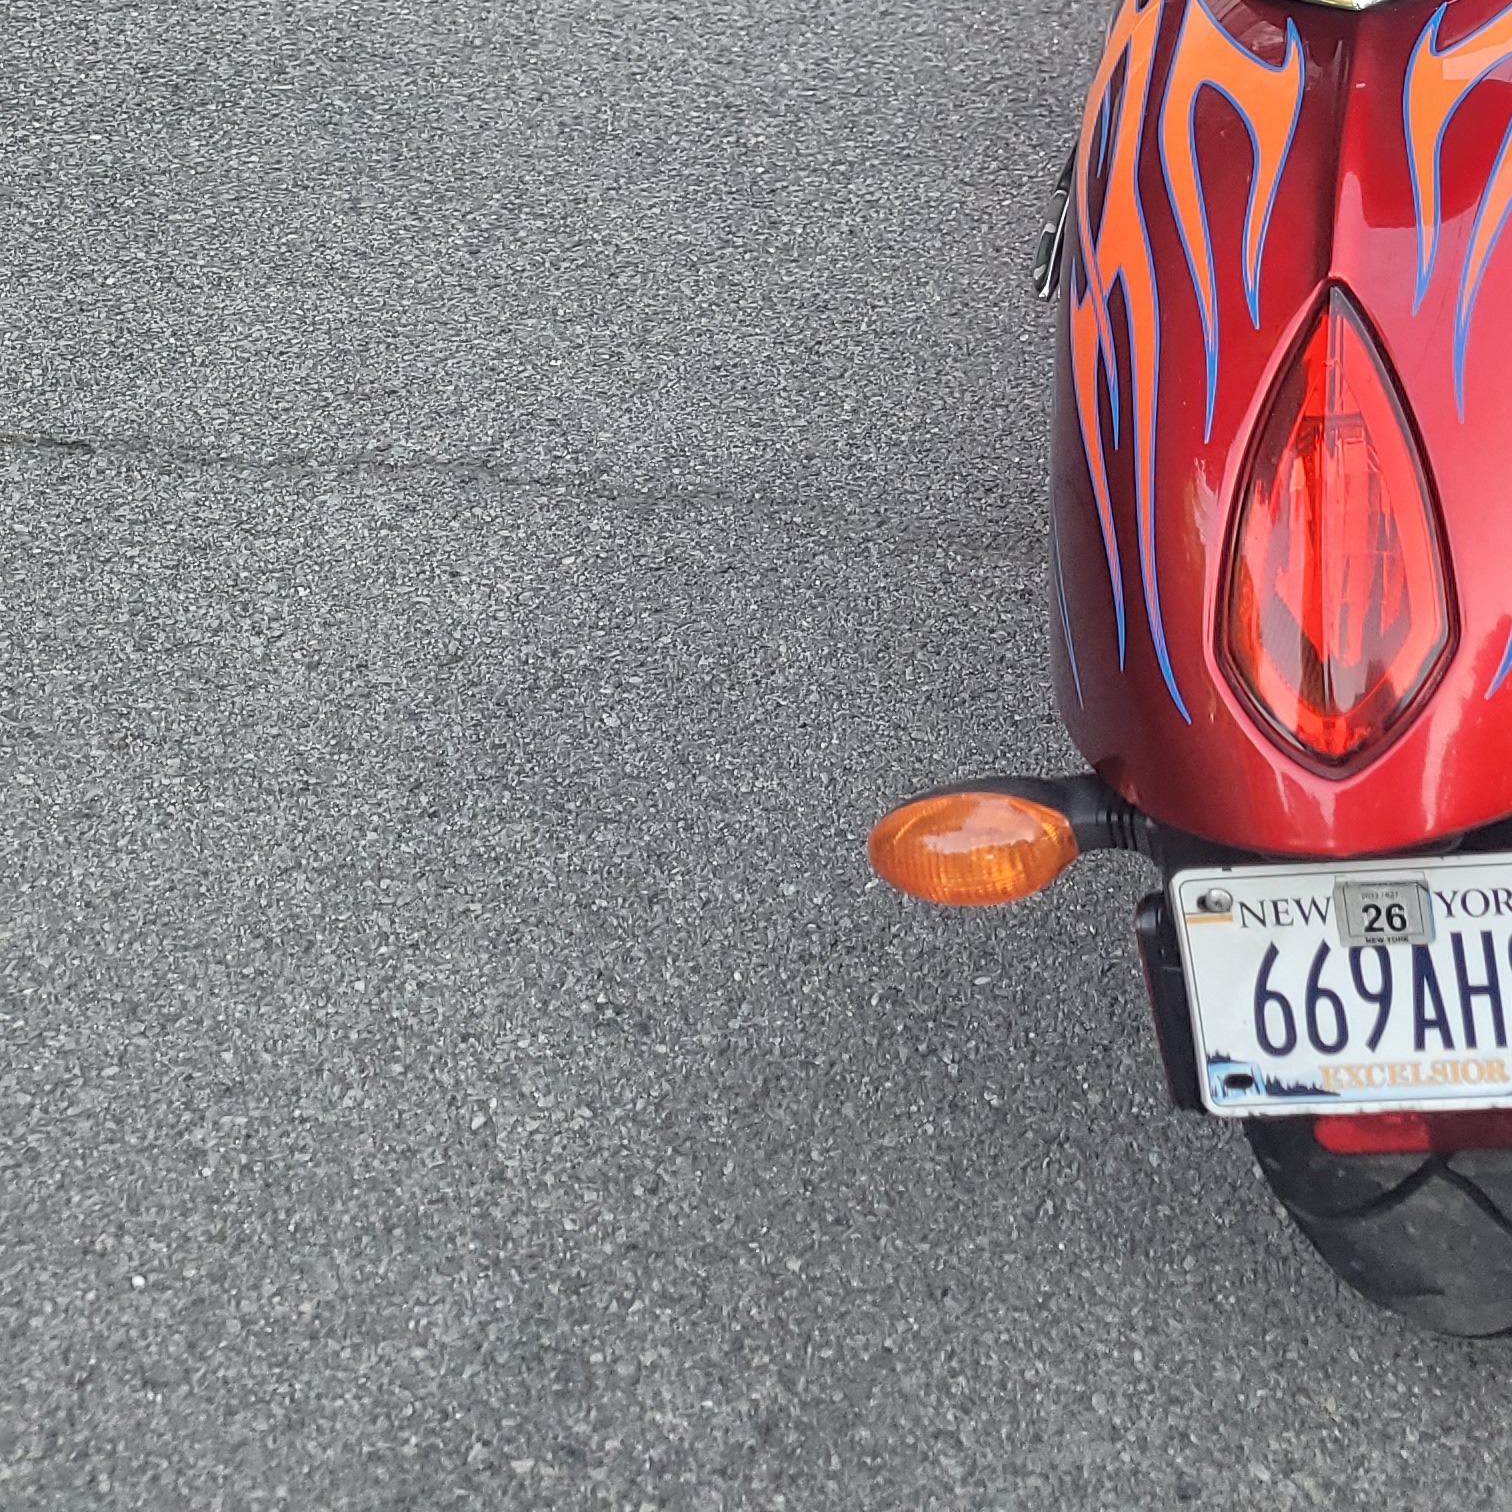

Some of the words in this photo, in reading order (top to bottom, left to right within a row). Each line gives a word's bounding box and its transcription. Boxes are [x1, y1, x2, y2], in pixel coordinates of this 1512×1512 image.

[1237, 896, 1332, 928] NEW
[1362, 903, 1407, 933] 26
[1318, 1056, 1511, 1092] EXCELSIOR
